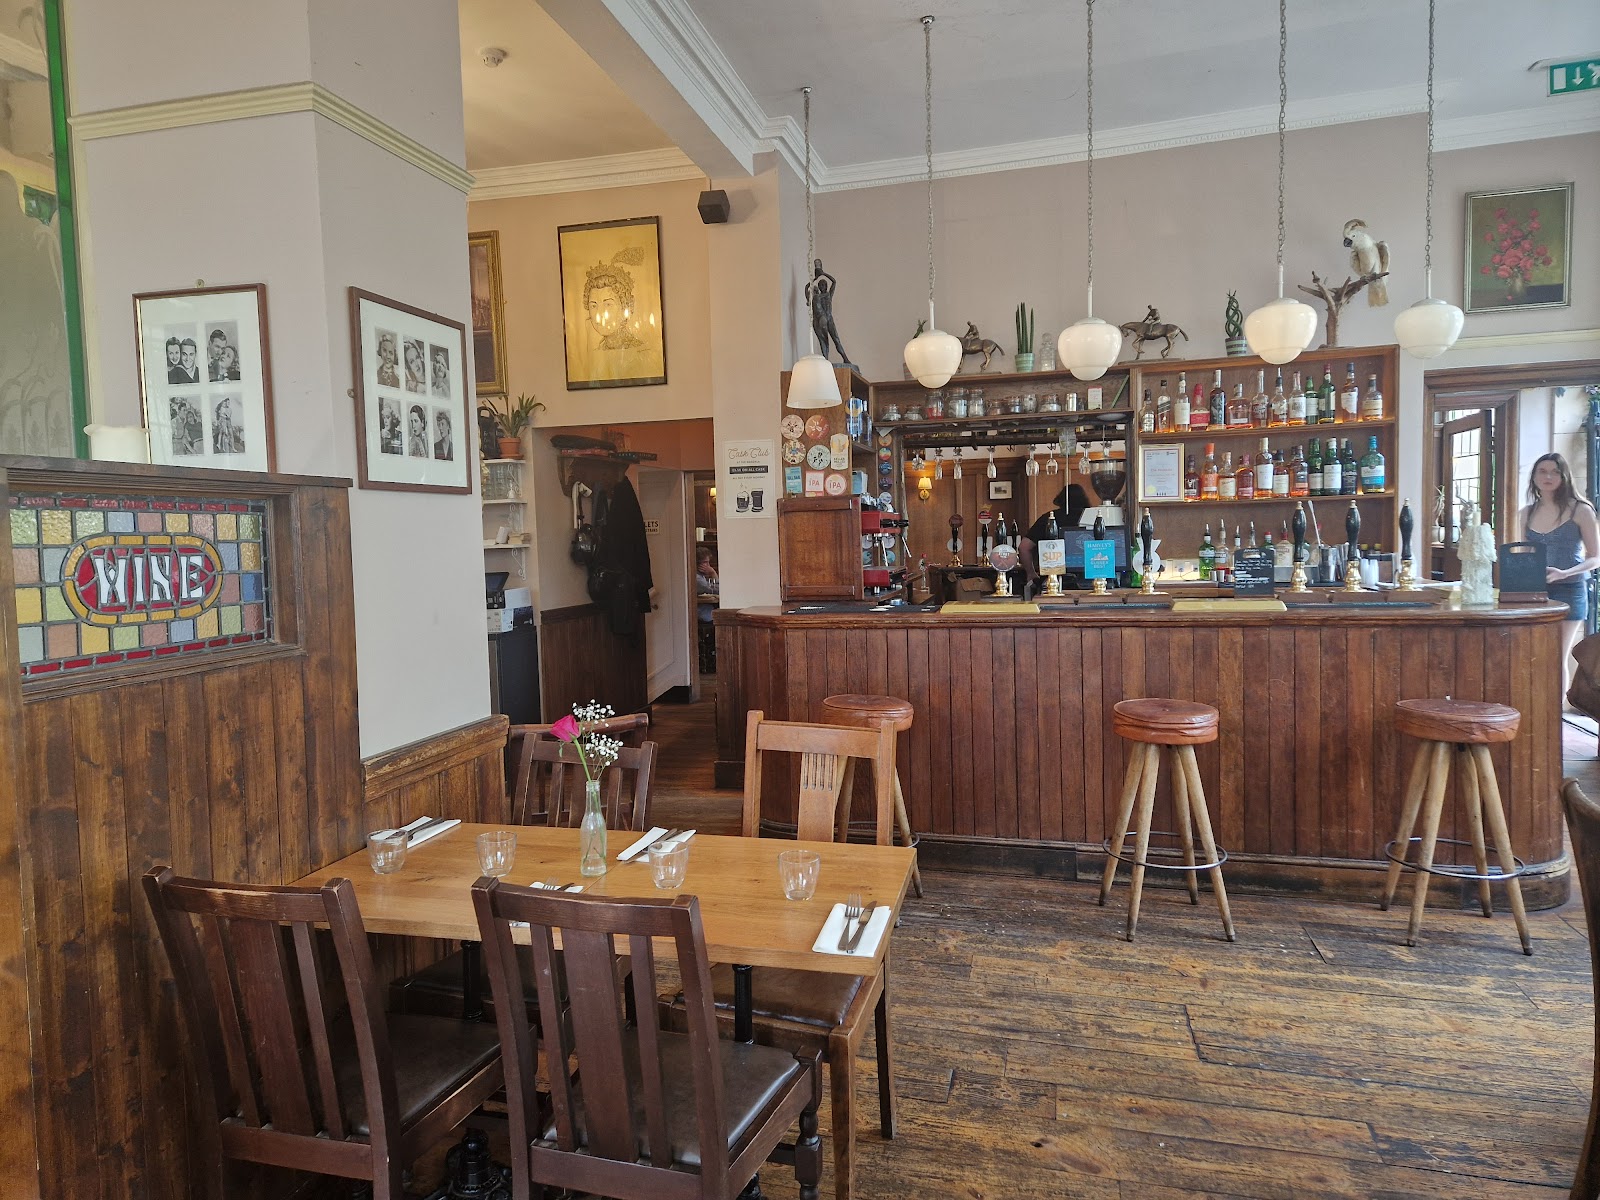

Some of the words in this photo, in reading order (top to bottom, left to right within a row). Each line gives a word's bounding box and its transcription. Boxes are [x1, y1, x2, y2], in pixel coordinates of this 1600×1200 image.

[728, 447, 749, 460] Cask
[749, 446, 770, 459] Club
[1042, 552, 1062, 561] SUP
[94, 554, 205, 605] WINE
